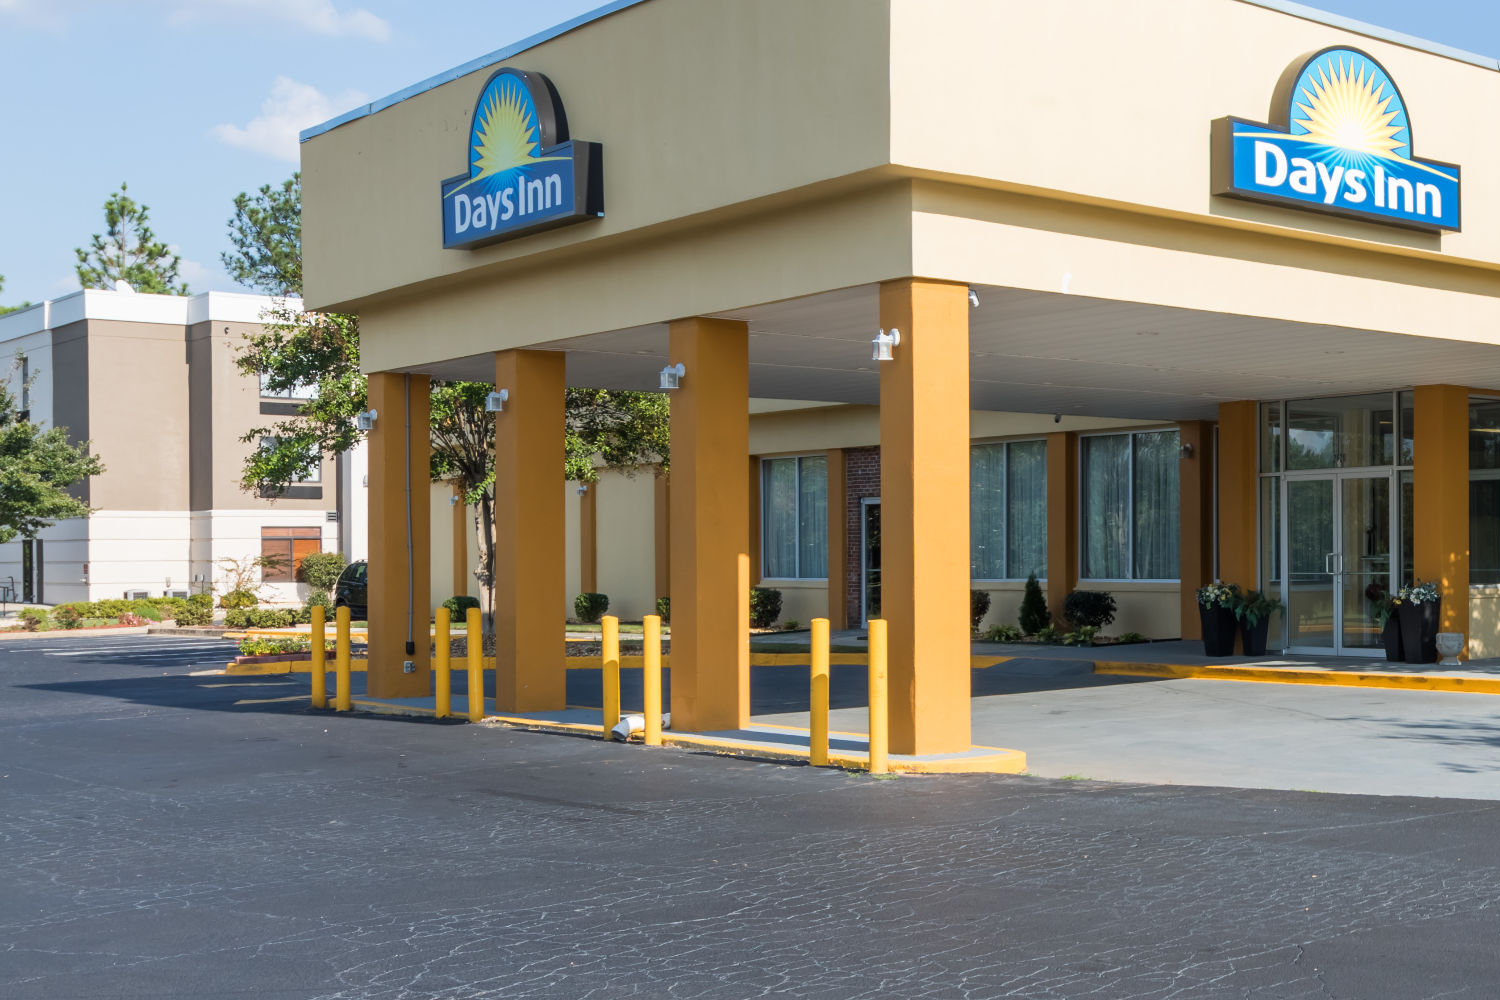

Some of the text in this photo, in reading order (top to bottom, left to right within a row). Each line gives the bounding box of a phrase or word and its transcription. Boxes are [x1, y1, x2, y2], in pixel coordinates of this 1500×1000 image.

[454, 173, 562, 234] Days Inn
[1254, 140, 1442, 218] Days Inn
